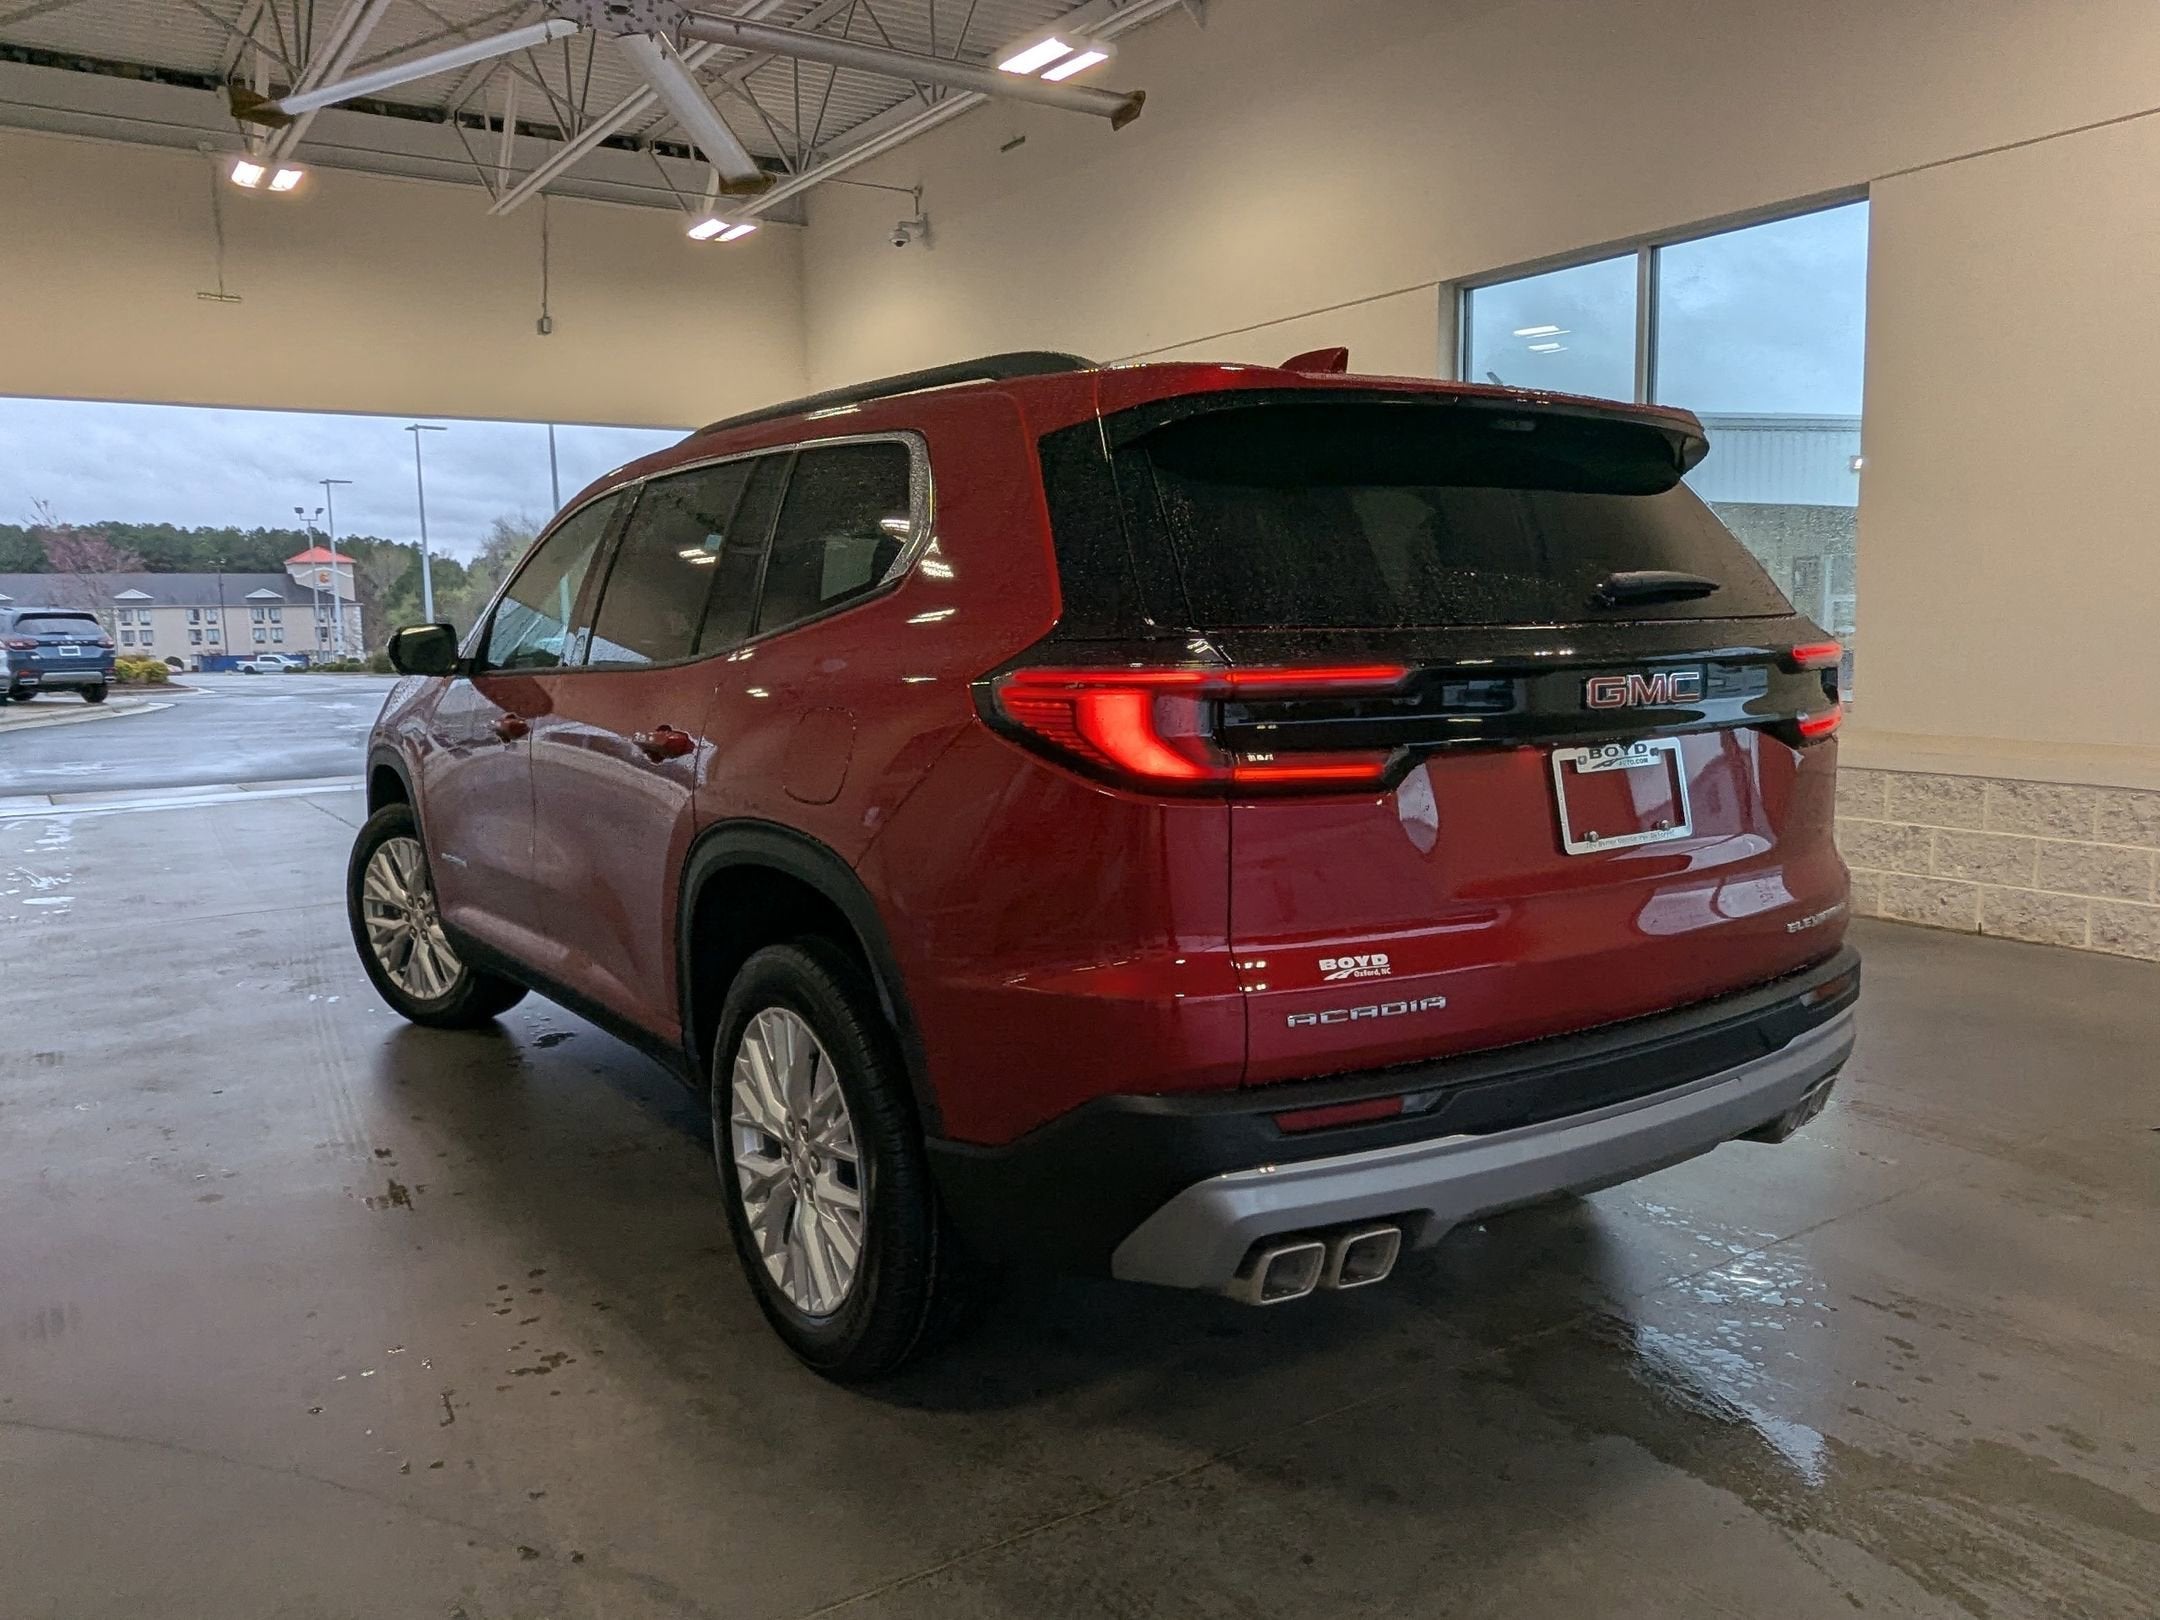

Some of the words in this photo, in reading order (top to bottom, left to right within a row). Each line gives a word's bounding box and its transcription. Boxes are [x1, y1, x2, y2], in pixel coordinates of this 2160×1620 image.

[1586, 672, 1699, 708] GMC
[1588, 743, 1647, 760] BOYD
[1319, 953, 1389, 971] BOYD
[1354, 969, 1381, 978] Oxford,
[1381, 968, 1391, 976] NC
[1287, 996, 1447, 1028] ACADIA
